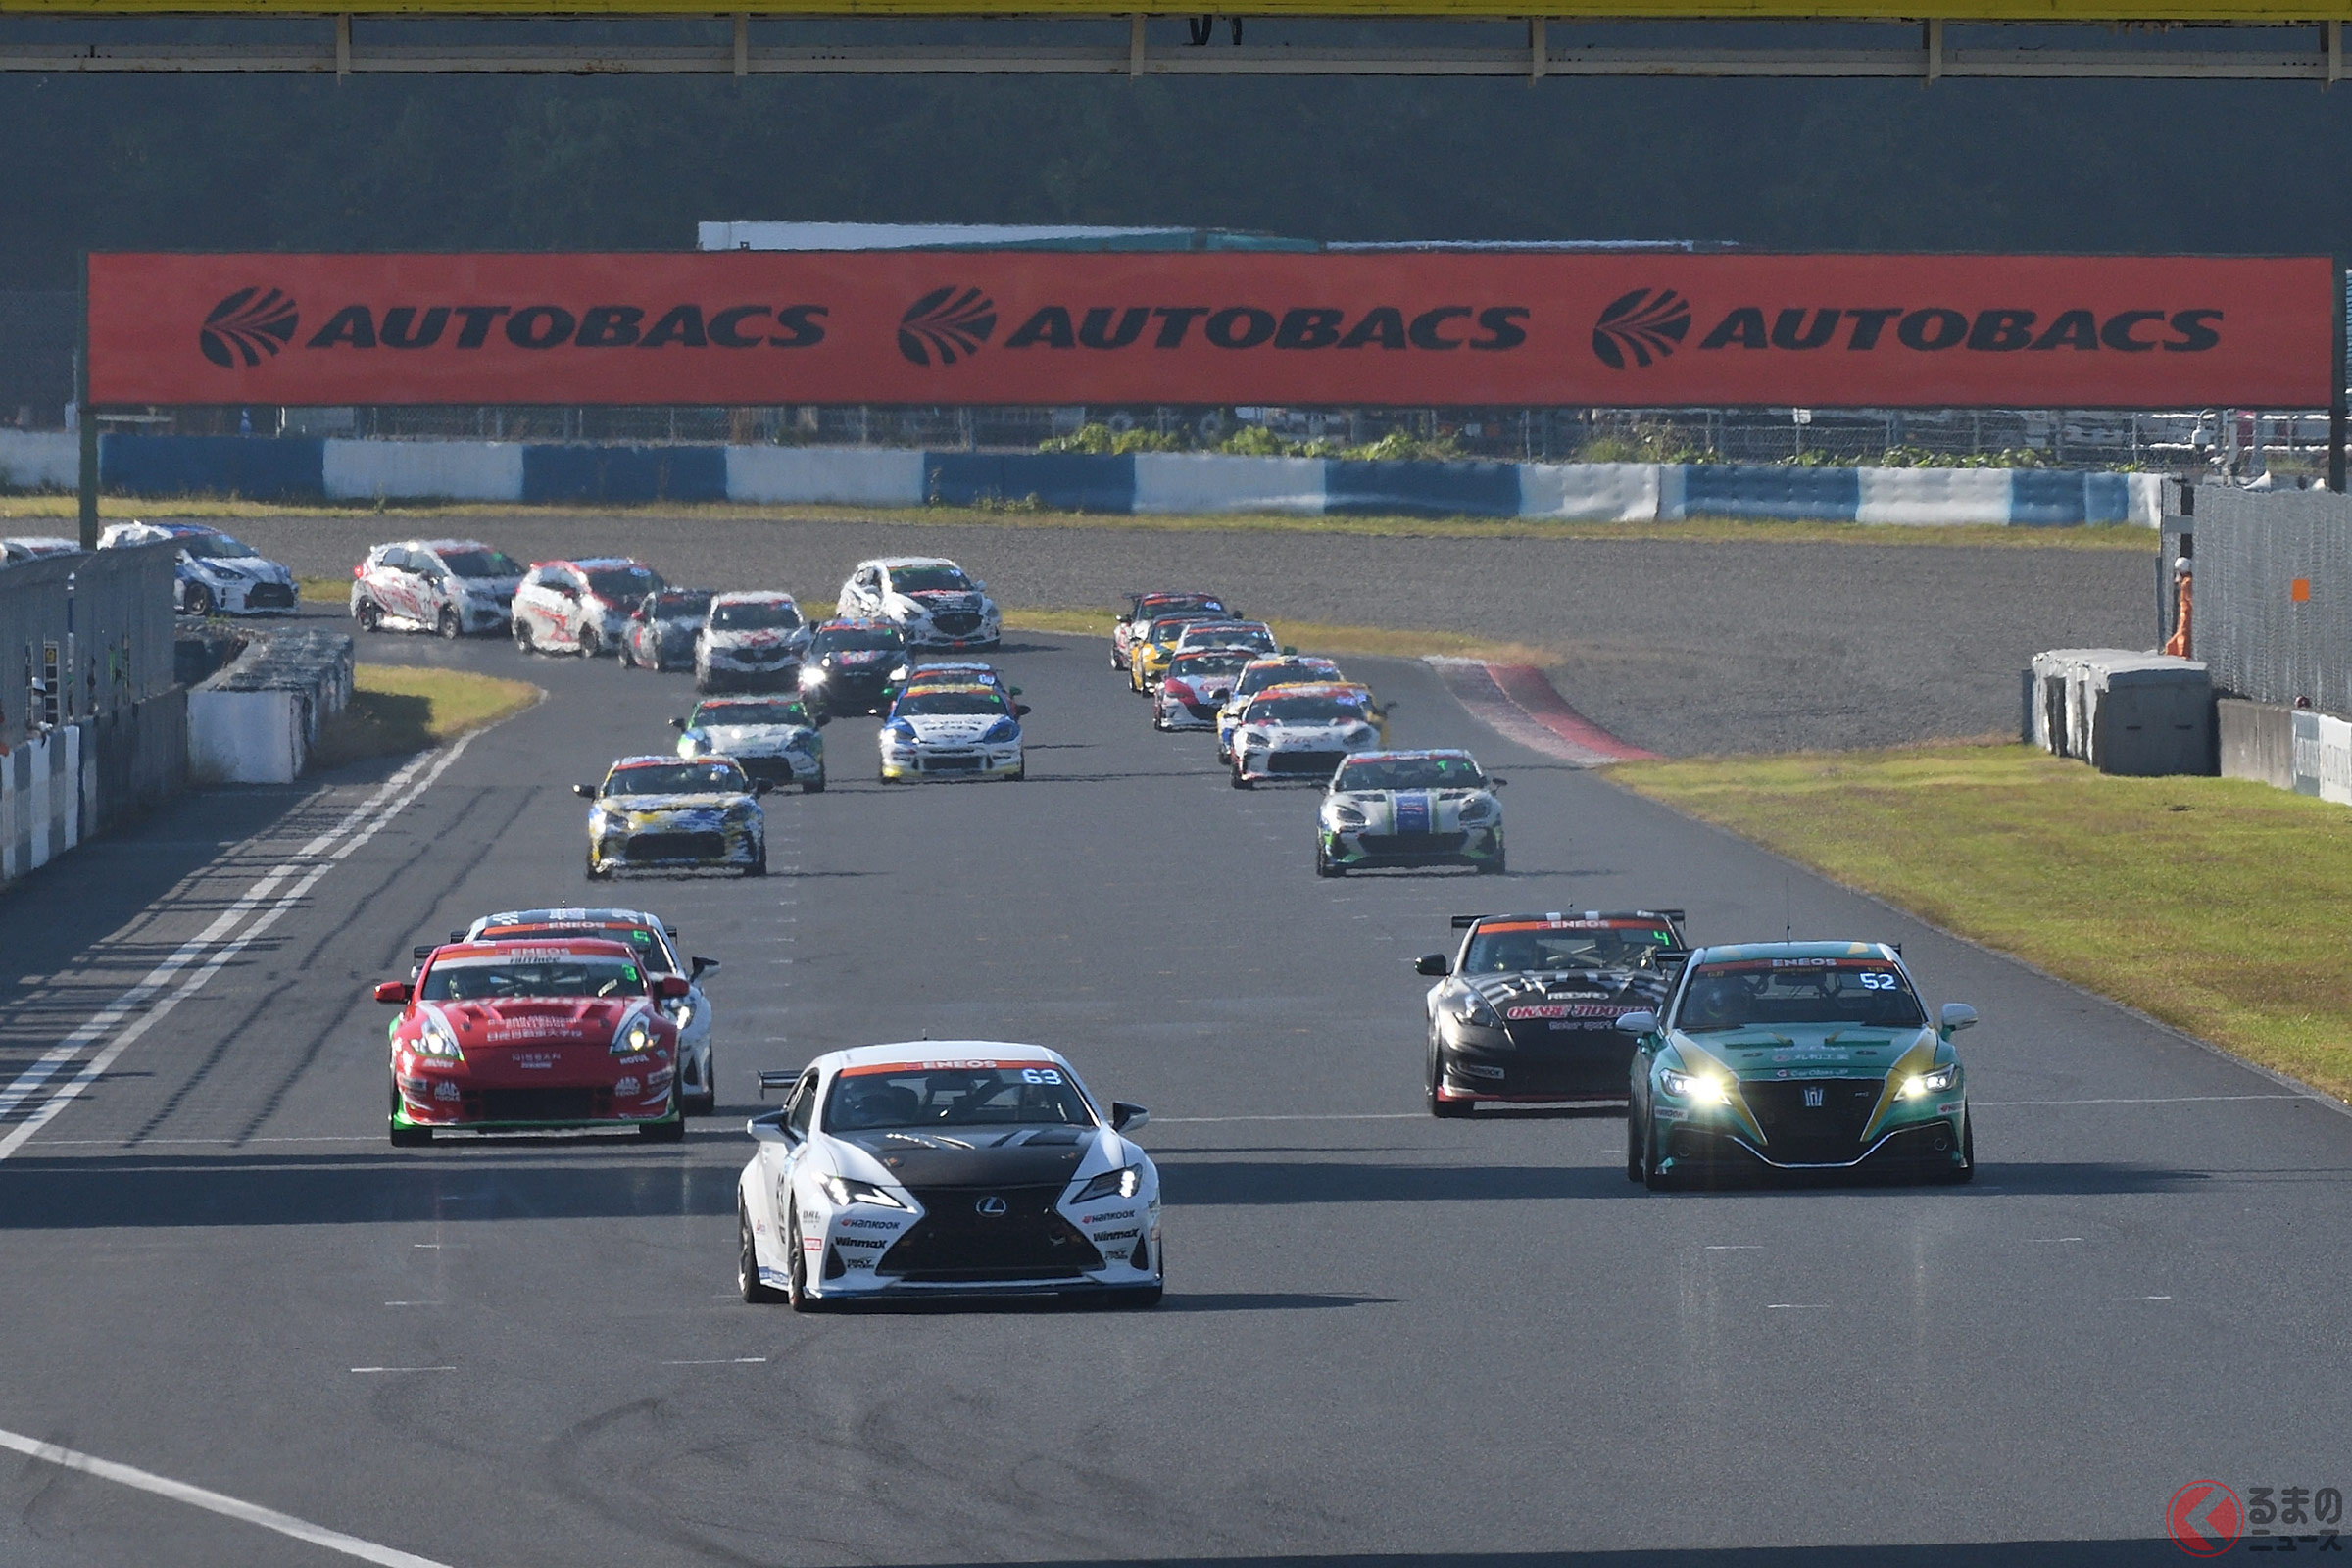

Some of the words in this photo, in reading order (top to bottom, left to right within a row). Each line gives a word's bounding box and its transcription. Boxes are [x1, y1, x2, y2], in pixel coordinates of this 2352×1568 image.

[306, 303, 829, 350] AUTOBACS
[1004, 305, 1531, 351] AUTOBACS
[1698, 307, 2224, 352] AUTOBACS
[1550, 920, 1610, 929] ENEOS
[1653, 930, 1670, 946] 4
[511, 947, 571, 956] ENEOS
[1771, 958, 1838, 968] ENEOS
[1859, 972, 1897, 991] 52
[1546, 991, 1610, 1001] RECARO
[512, 1053, 561, 1062] NISSAN
[923, 1060, 997, 1069] ENEOS
[1021, 1068, 1063, 1086] 63
